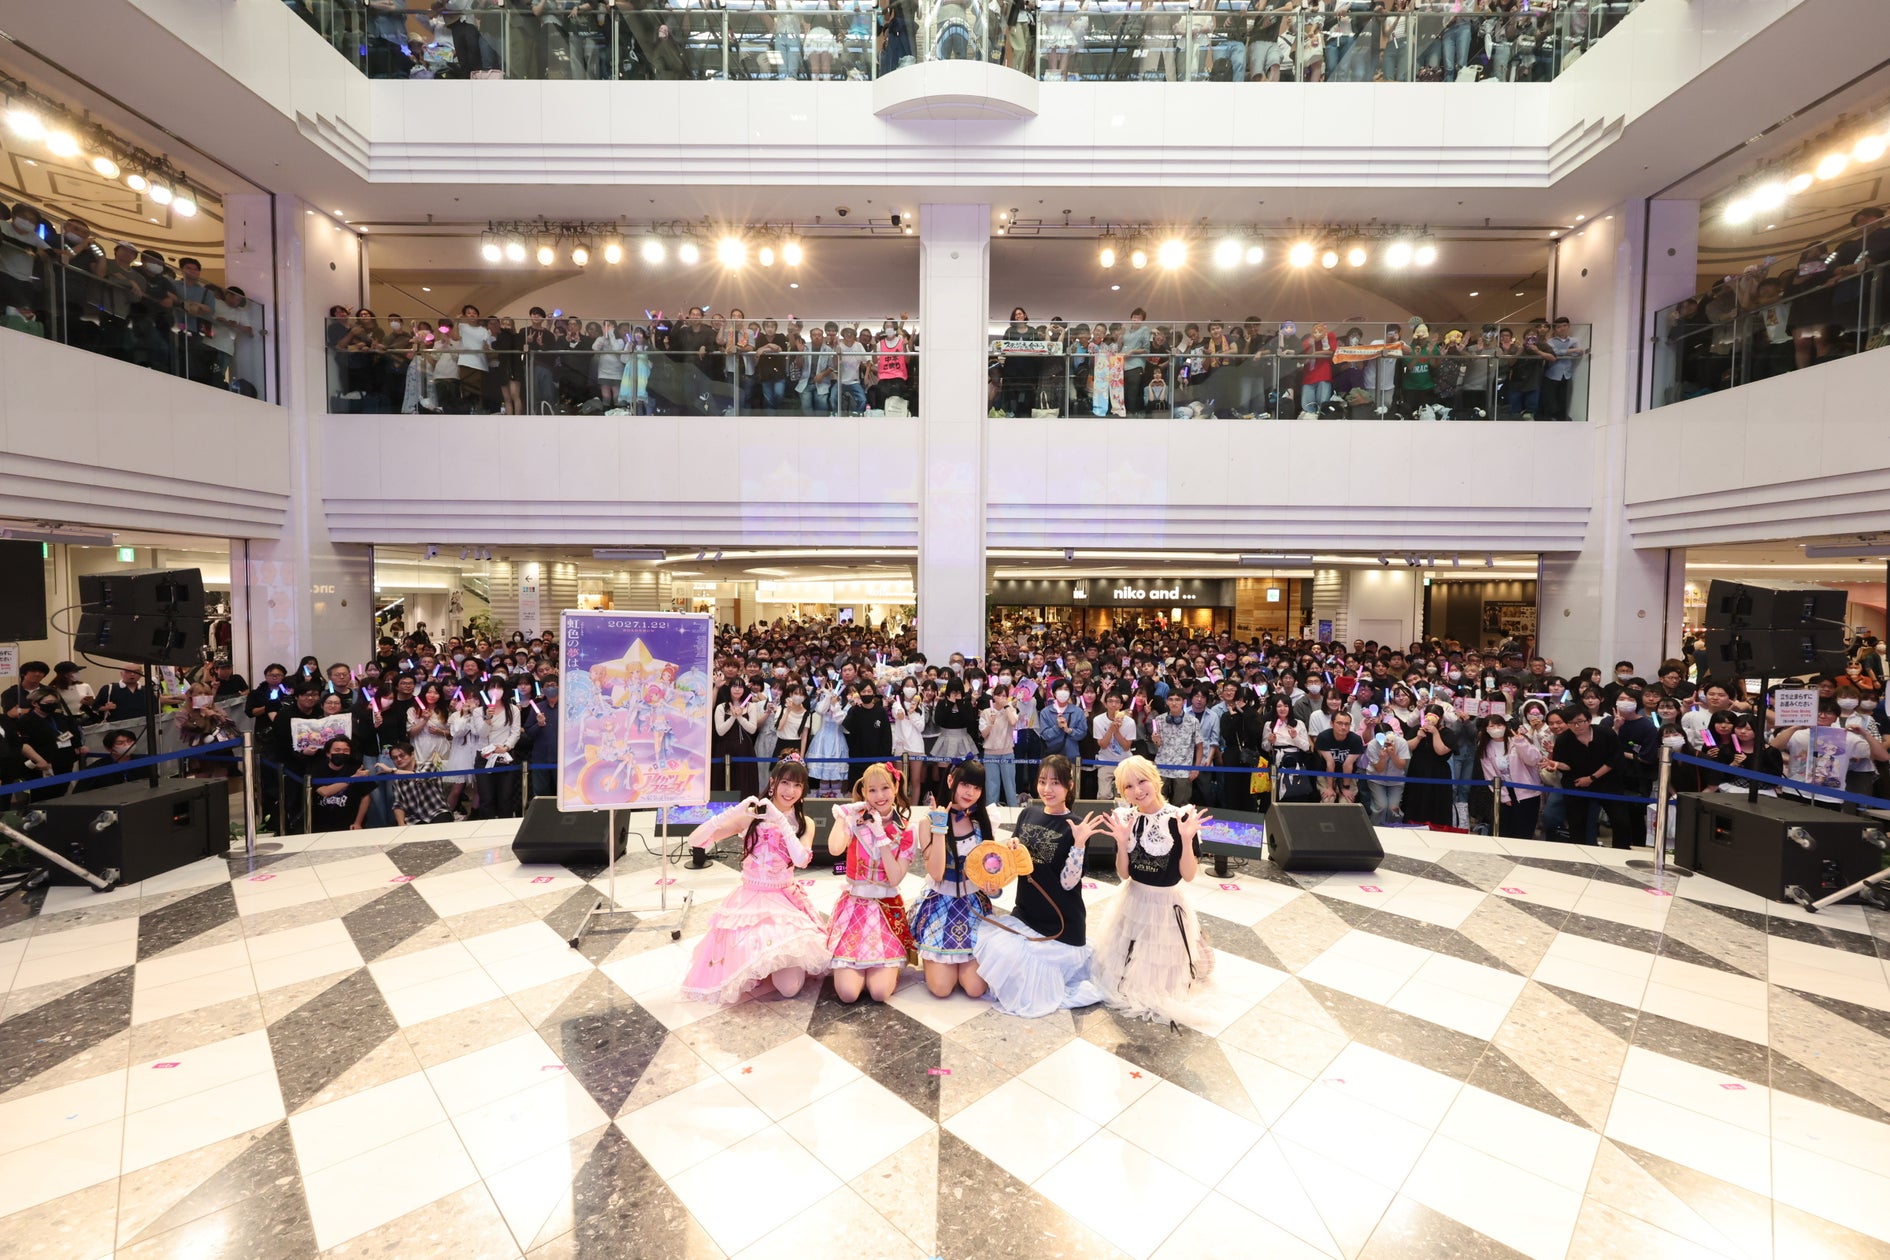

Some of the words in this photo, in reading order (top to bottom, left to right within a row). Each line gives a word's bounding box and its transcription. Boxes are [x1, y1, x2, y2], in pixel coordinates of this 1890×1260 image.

[1113, 586, 1146, 599] niko
[1149, 586, 1179, 599] and
[607, 620, 666, 629] 2027.1.22
